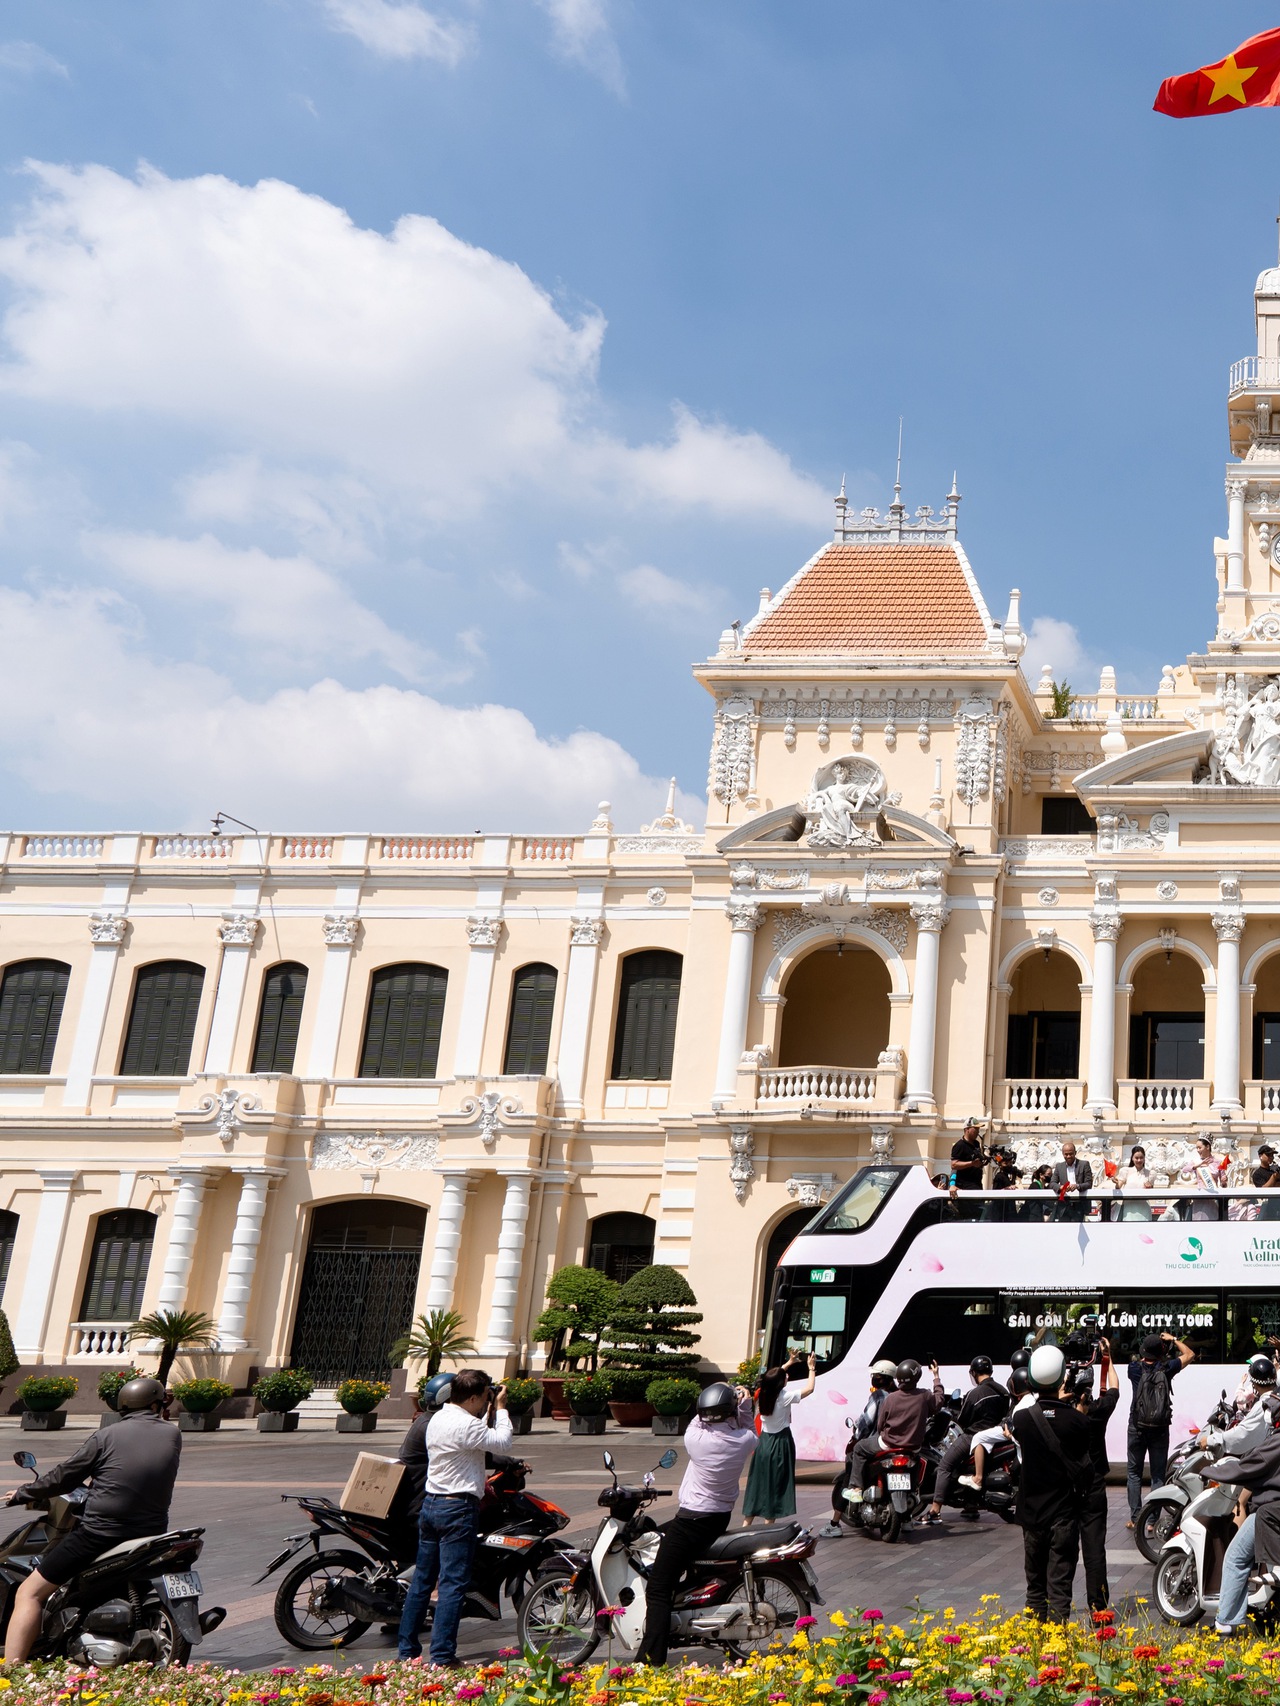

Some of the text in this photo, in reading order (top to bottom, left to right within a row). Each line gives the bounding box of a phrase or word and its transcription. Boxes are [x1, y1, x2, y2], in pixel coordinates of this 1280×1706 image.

[1008, 1311, 1031, 1328] SÀI
[1035, 1311, 1062, 1328] GÒN
[1079, 1311, 1107, 1330] CỢ
[1110, 1311, 1138, 1328] LỚN
[1141, 1314, 1173, 1328] CITY
[1177, 1314, 1214, 1328] TOUR
